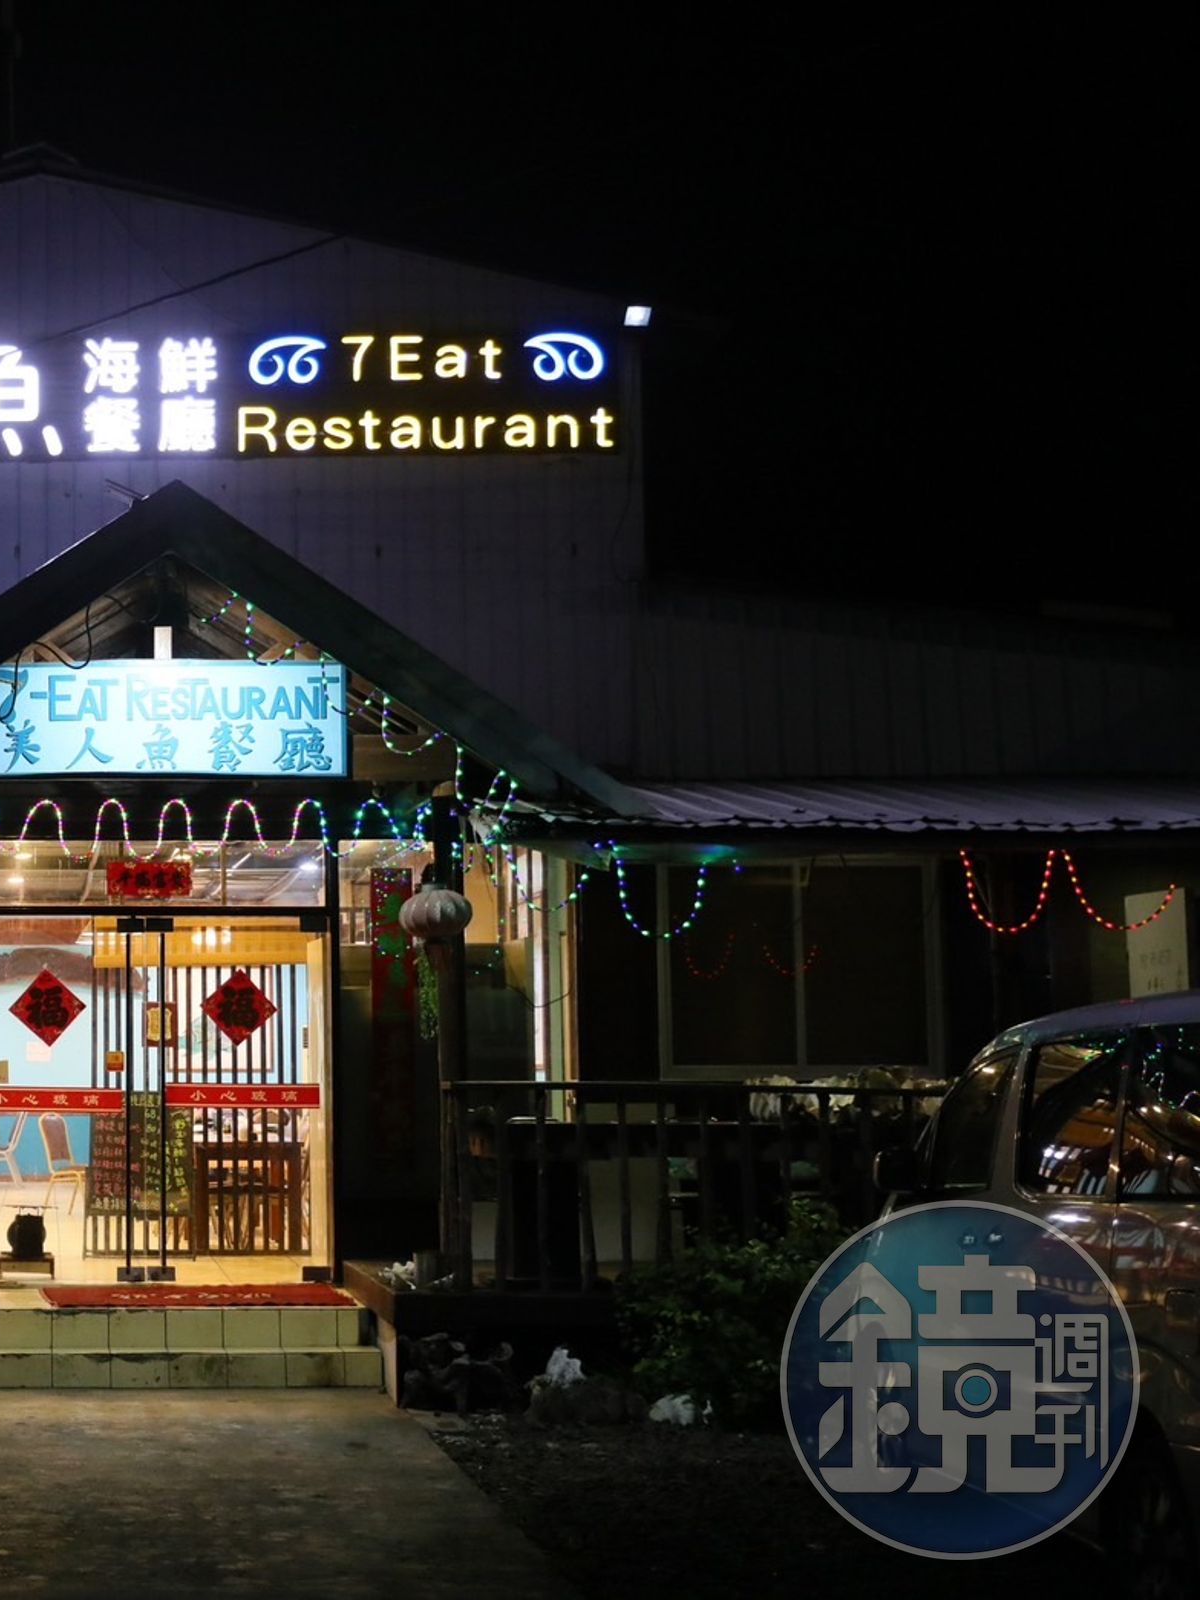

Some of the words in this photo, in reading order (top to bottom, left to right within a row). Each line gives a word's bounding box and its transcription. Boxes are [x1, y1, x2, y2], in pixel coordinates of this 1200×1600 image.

[83, 337, 217, 393] 海鮮
[83, 396, 217, 454] 餐廳
[237, 406, 614, 453] Restaurant
[126, 673, 340, 722] RESTAURANT
[3, 719, 332, 774] 美人魚餐廳
[26, 985, 69, 1029] 福
[217, 985, 260, 1029] 福
[190, 1090, 298, 1102] 小心玻璃
